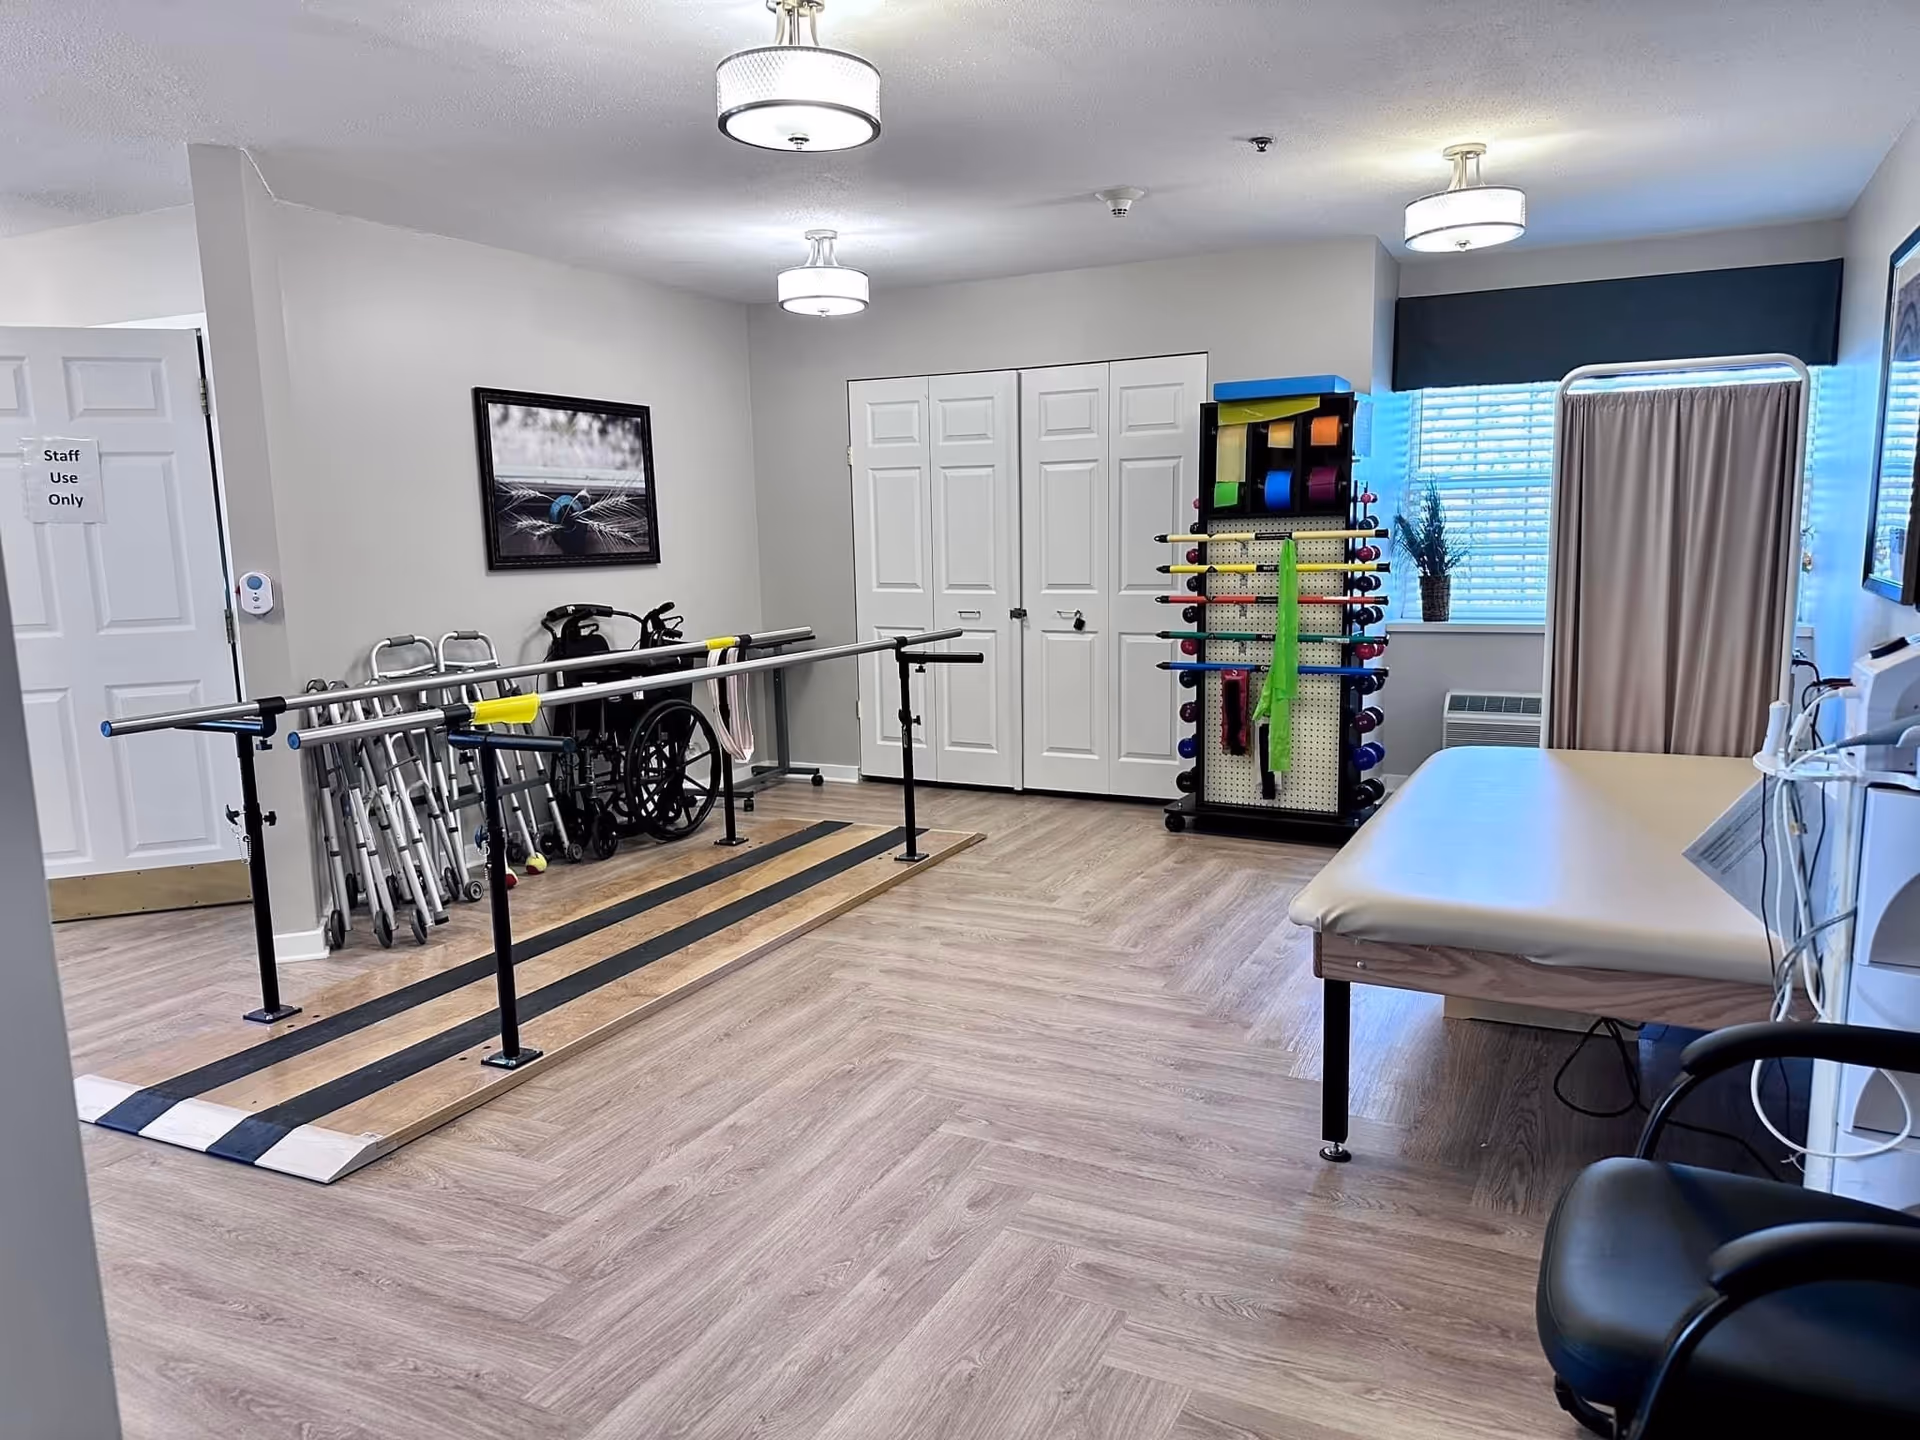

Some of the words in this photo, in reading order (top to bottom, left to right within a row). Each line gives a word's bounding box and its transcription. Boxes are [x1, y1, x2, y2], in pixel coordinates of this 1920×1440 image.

[44, 449, 80, 462] Staff
[50, 472, 78, 484] Use
[48, 493, 84, 508] Only
